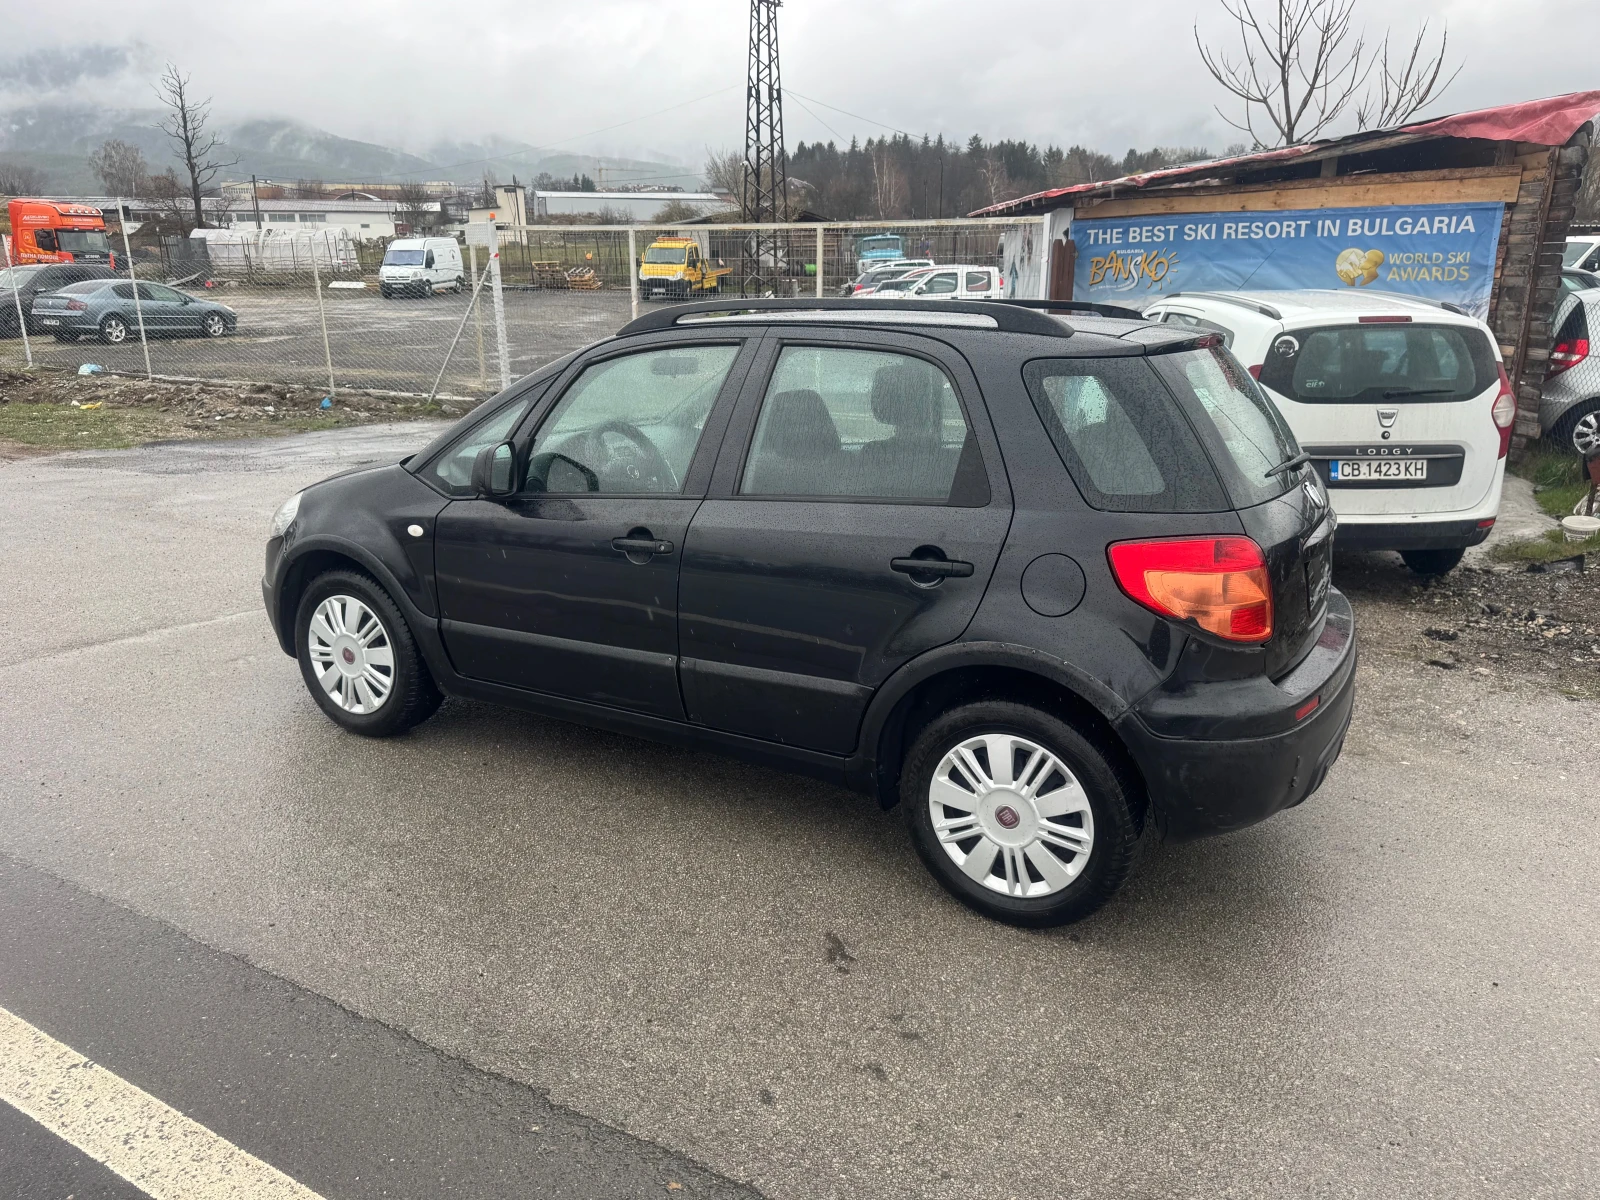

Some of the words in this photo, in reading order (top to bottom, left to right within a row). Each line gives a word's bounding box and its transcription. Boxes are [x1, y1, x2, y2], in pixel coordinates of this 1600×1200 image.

[1087, 228, 1123, 245] THE
[1128, 225, 1178, 243] BEST
[1183, 223, 1216, 240] SKI
[1222, 220, 1310, 240] RESORT
[1316, 219, 1341, 237] IN
[1347, 215, 1476, 236] BULGARIA
[1388, 252, 1443, 265] WORLD
[1447, 251, 1471, 264] SKI
[1089, 250, 1169, 291] BANSKO
[1386, 265, 1470, 282] AWARDS
[1341, 462, 1361, 477] CB
[1366, 462, 1401, 477] 1423
[1404, 461, 1424, 477] KH
[999, 809, 1016, 825] FIAT
